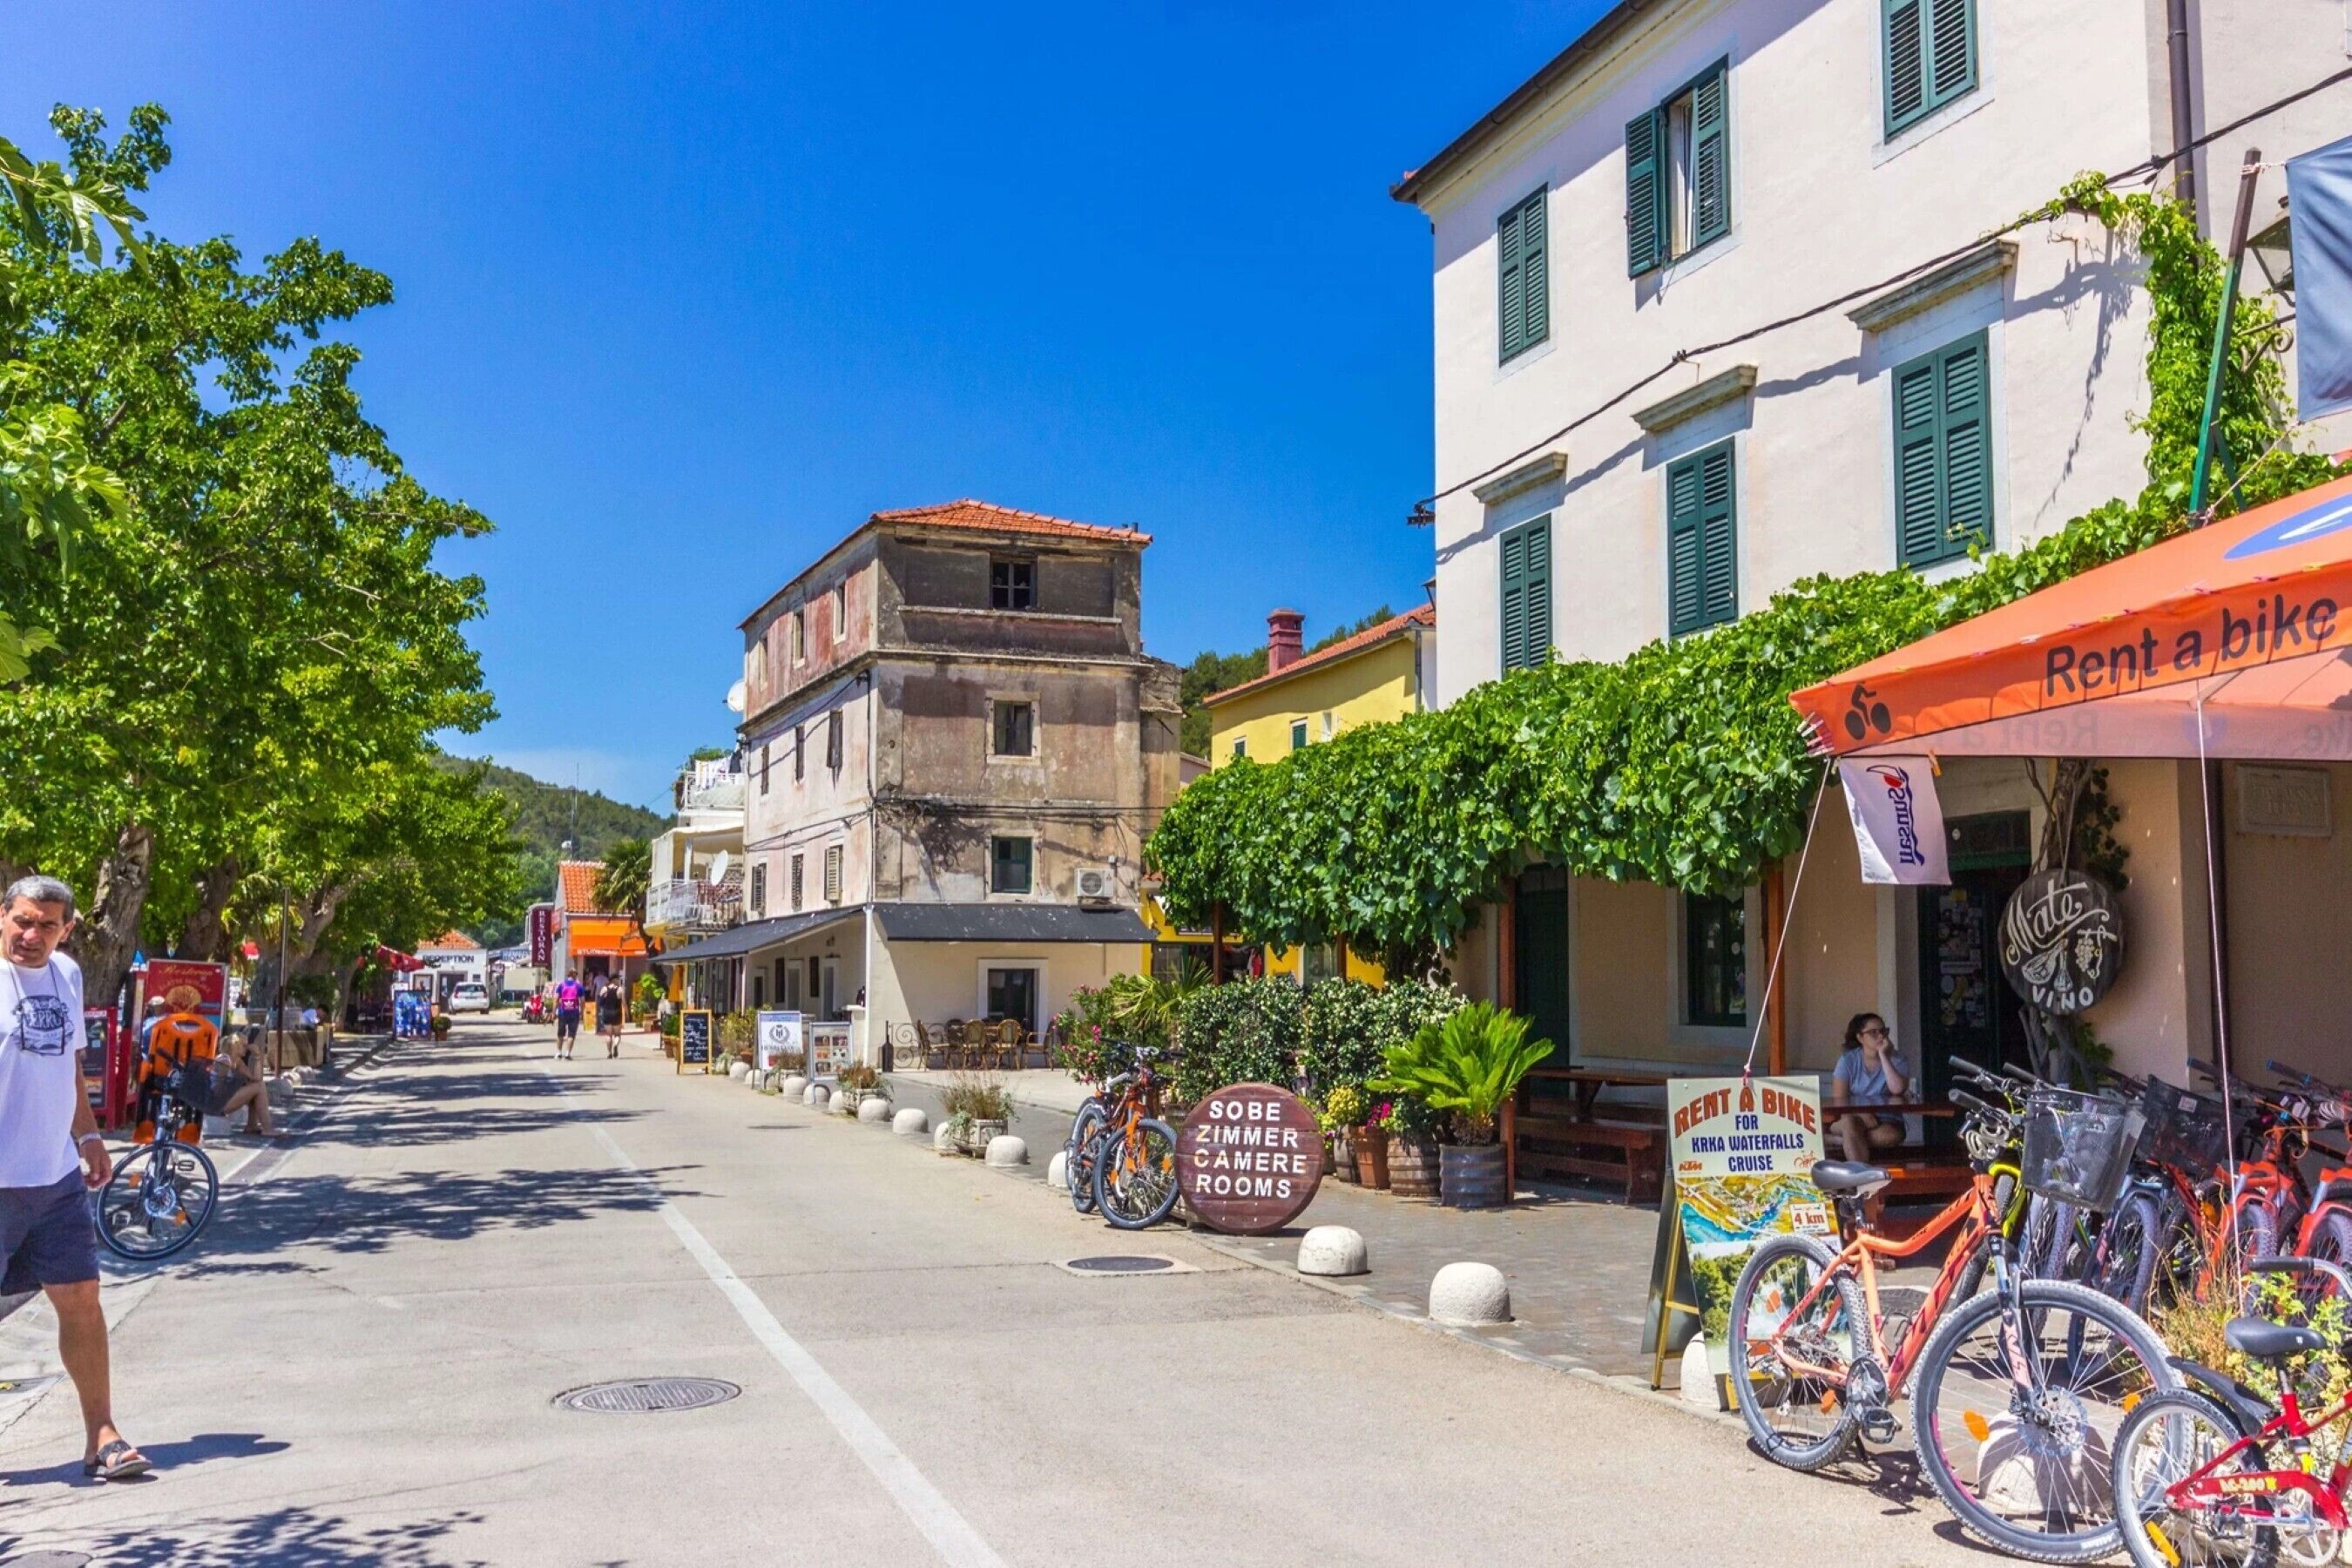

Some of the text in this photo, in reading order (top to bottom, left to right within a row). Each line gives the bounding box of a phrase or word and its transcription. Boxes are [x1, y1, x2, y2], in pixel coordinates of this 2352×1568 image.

[2046, 594, 2338, 697] Rent a bike
[2006, 879, 2109, 965] Mate
[537, 910, 546, 961] RESTORAN
[2032, 985, 2094, 1010] VINO
[1209, 1100, 1281, 1121] SOBE
[1674, 1086, 1816, 1139] RENT A BIKE
[1735, 1114, 1759, 1131] FOR
[1196, 1125, 1298, 1148] ZIMMER
[1692, 1133, 1804, 1152] KRKA WATERFALLS
[1194, 1148, 1307, 1173] CAMERE
[1679, 1160, 1703, 1172] KTM
[1728, 1155, 1774, 1172] CRUISE
[1195, 1173, 1291, 1199] ROOMS
[1794, 1212, 1825, 1225] 4 km
